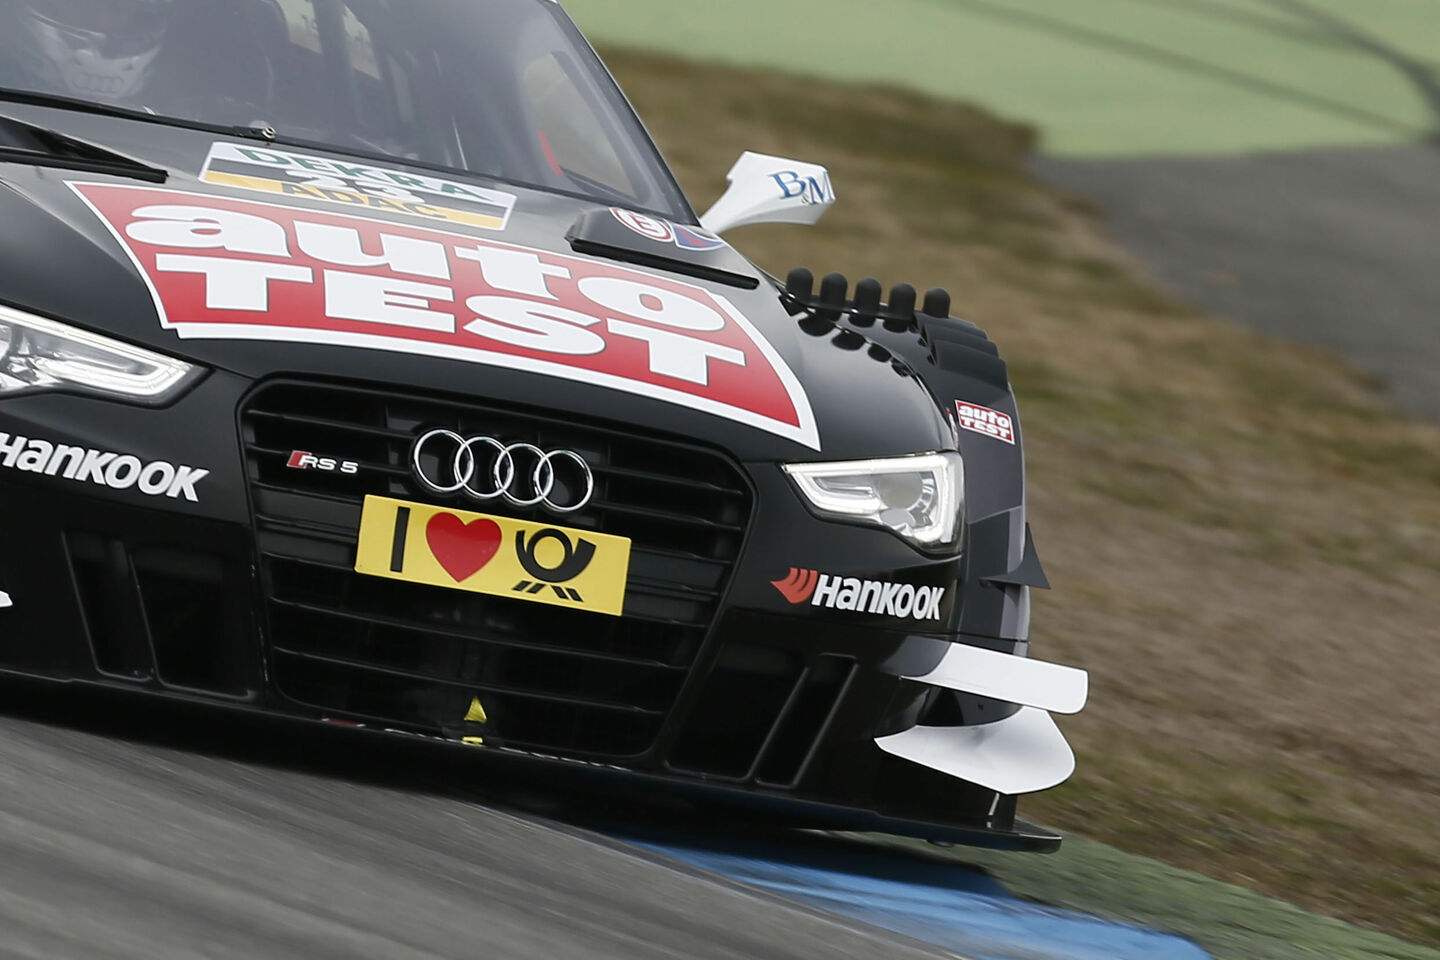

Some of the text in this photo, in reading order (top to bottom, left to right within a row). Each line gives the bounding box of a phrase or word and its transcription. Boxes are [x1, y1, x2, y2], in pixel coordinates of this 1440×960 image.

[234, 147, 494, 202] DEKRA
[285, 169, 427, 203] 23
[281, 182, 448, 218] ADAC
[125, 205, 727, 331] auto
[156, 253, 747, 386] TEST
[959, 405, 1010, 428] auto
[960, 416, 1011, 438] TEST
[298, 454, 359, 474] RS 5
[390, 506, 411, 573] I
